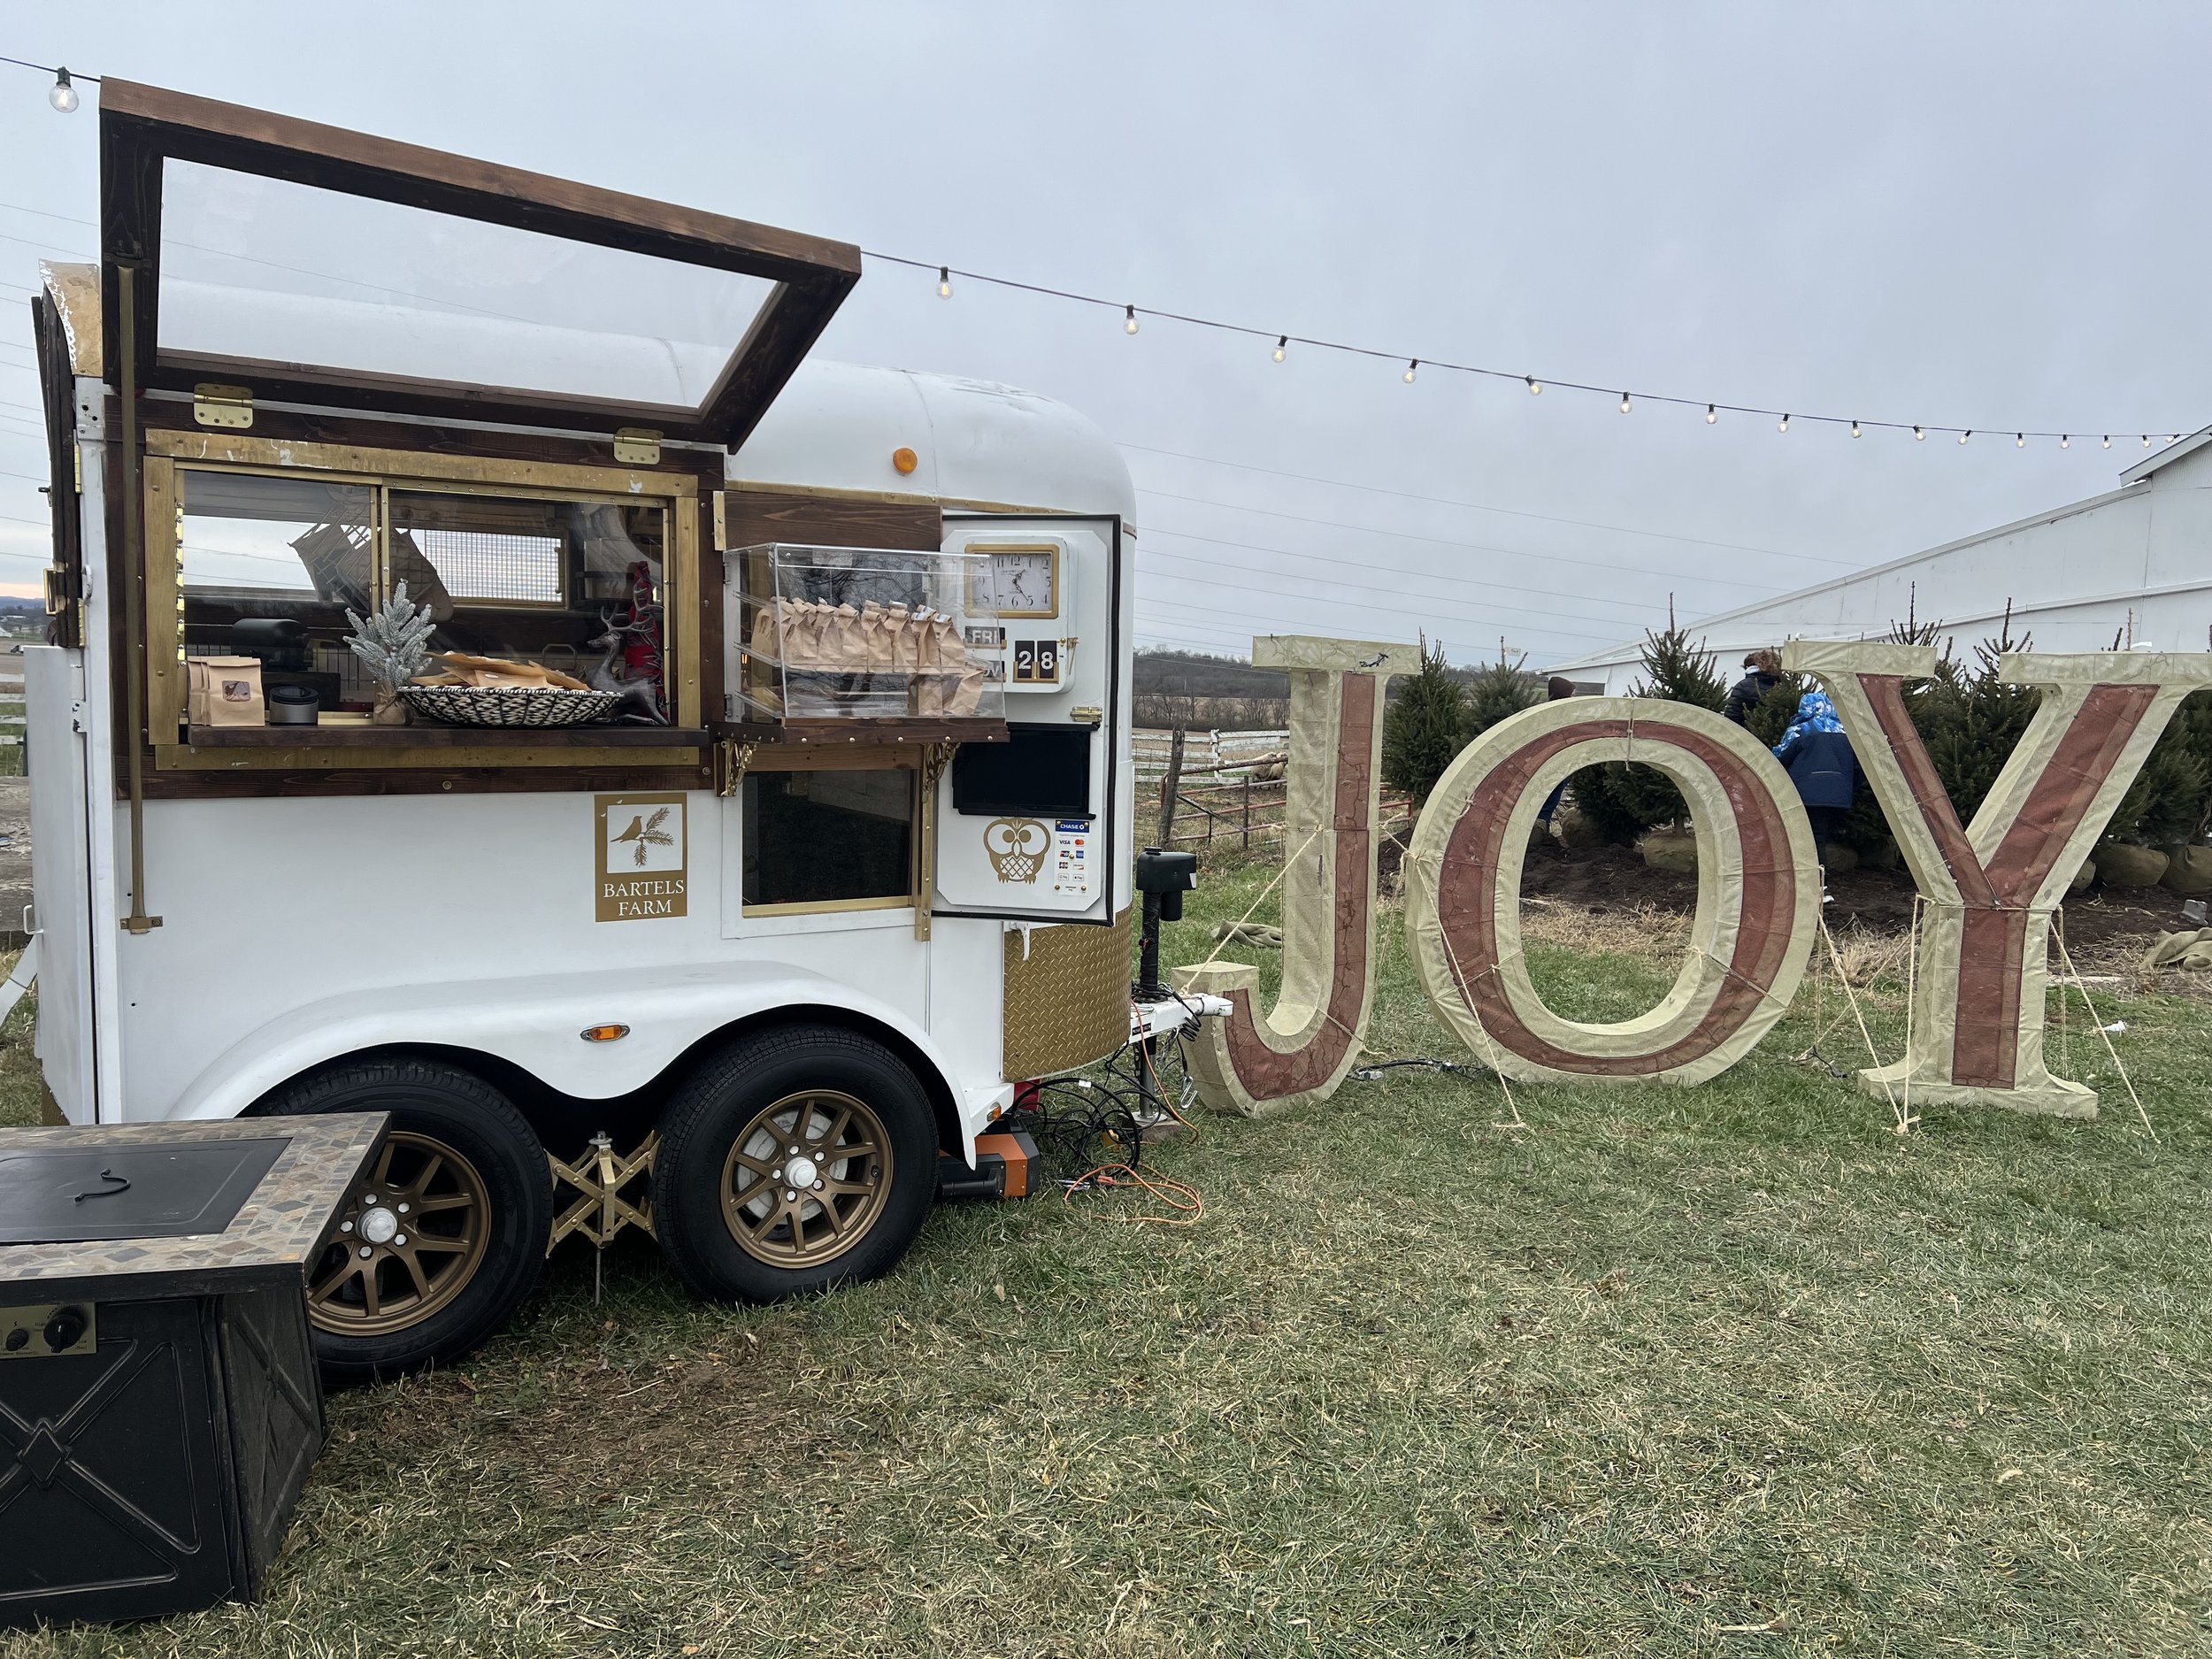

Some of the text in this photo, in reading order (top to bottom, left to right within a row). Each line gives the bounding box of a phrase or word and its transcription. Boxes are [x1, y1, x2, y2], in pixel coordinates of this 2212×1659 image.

[1010, 555, 1020, 566] 12
[1041, 558, 1048, 570] 2
[997, 595, 1004, 606] 7
[1011, 595, 1018, 608] 6
[1026, 595, 1034, 607] 5
[972, 630, 998, 644] FRI
[1172, 635, 2212, 1118] JOY
[603, 879, 684, 898] BARTELS
[618, 899, 672, 917] FARM
